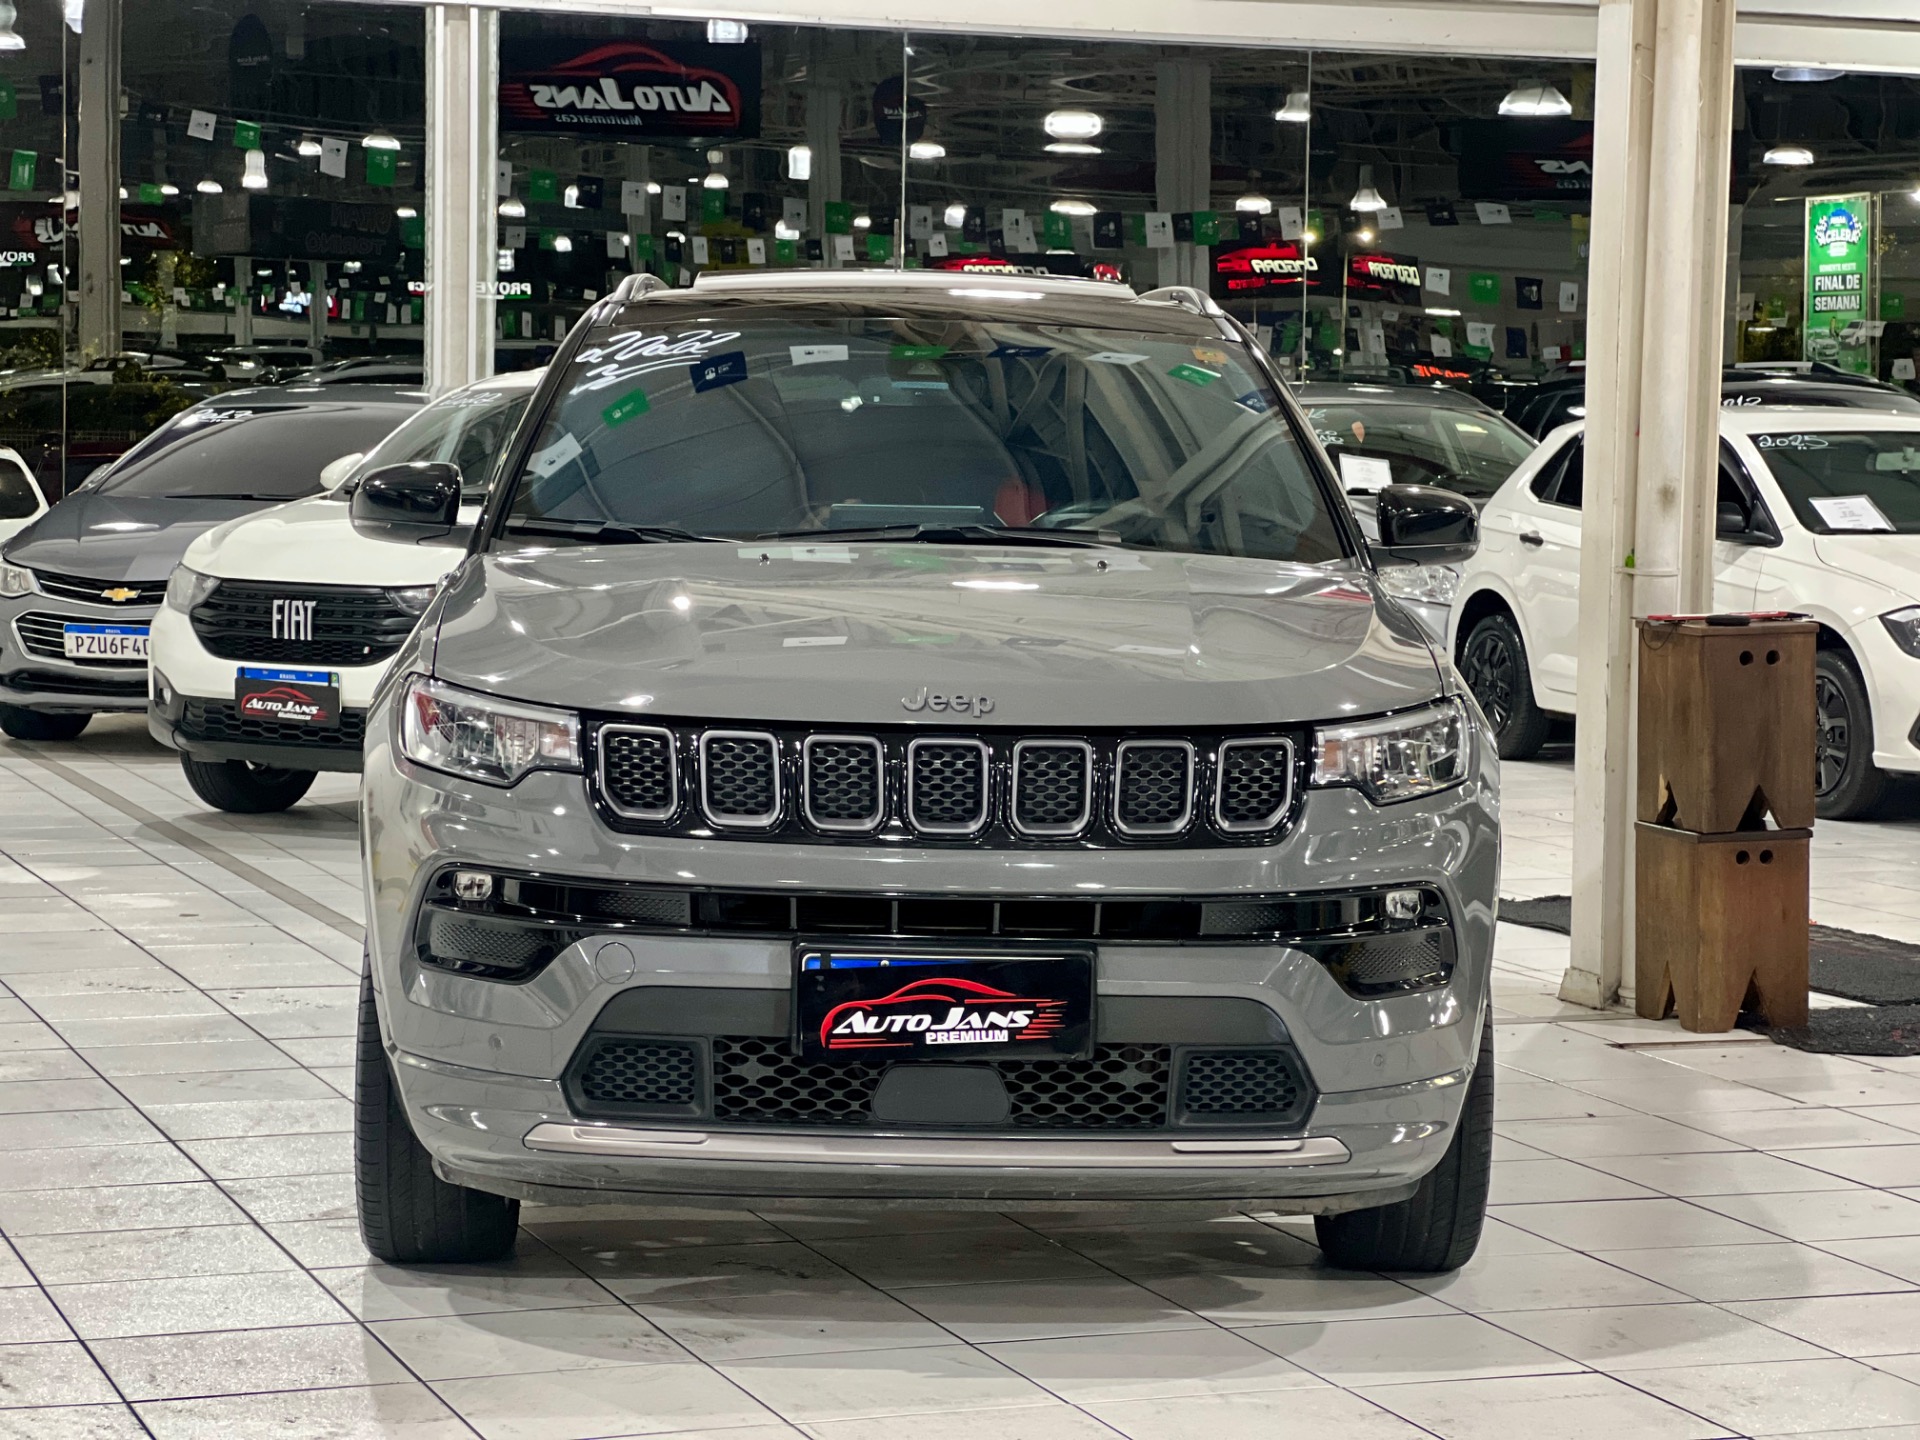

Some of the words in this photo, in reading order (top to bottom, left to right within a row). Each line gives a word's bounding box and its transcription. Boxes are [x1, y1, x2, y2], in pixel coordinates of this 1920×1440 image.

[1815, 275, 1844, 291] FINAL
[1846, 274, 1860, 289] DE
[1815, 296, 1860, 312] SEMANA!
[1759, 435, 1829, 449] 2025
[272, 599, 317, 641] FIAT
[245, 698, 283, 712] AUTO
[281, 701, 320, 715] JANS
[901, 686, 995, 719] Jeep
[832, 1010, 932, 1035] AUTO
[929, 1007, 1035, 1031] JANS
[925, 1029, 1010, 1045] PREMIUM
